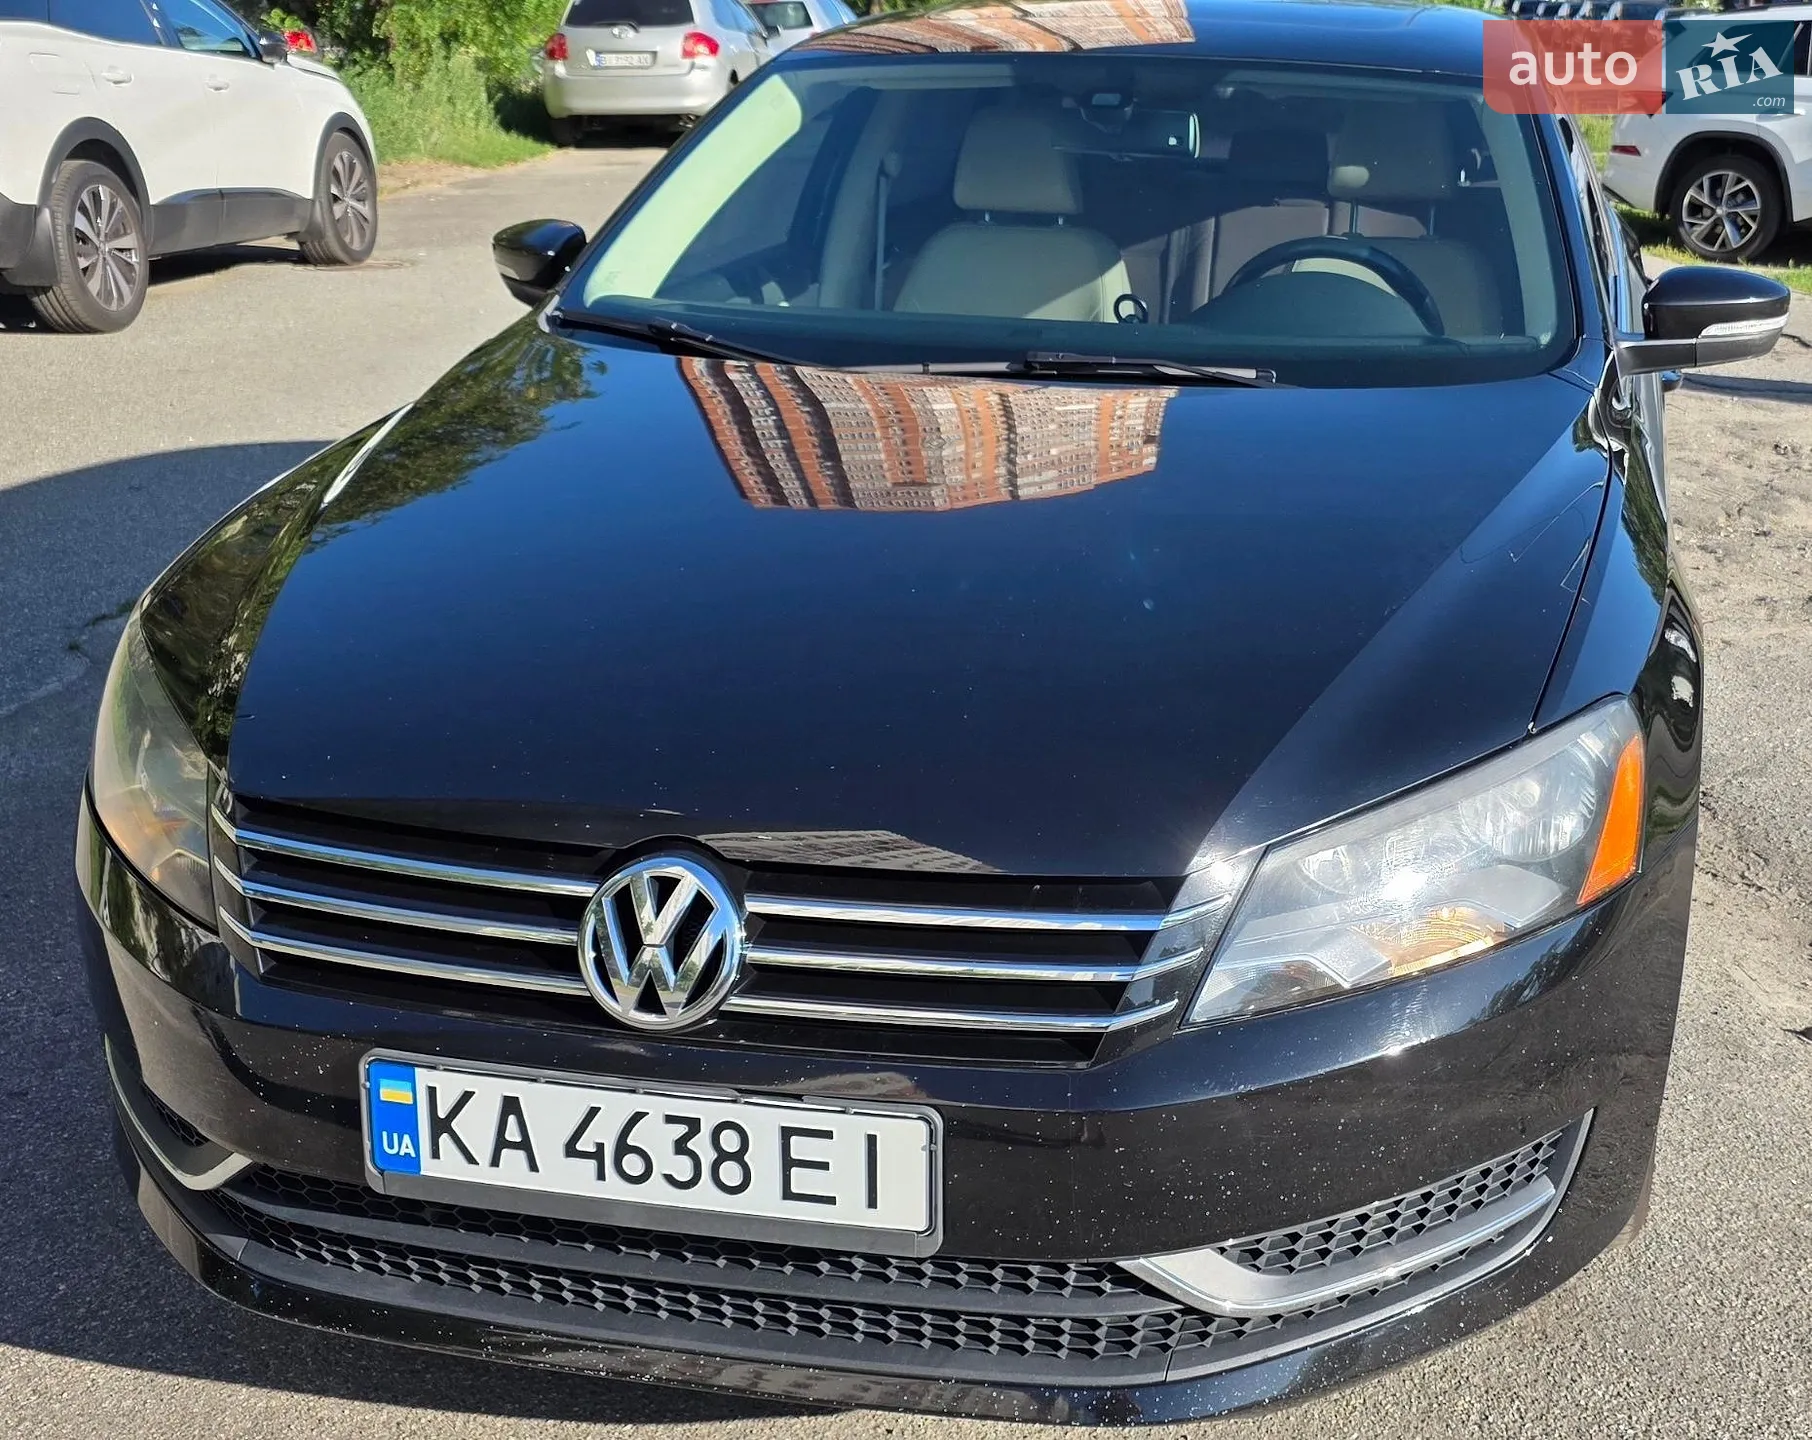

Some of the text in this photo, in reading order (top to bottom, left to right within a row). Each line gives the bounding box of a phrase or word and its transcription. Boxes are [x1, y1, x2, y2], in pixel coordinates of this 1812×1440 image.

[382, 1130, 416, 1158] UA
[425, 1085, 878, 1210] KA 4638 EI
